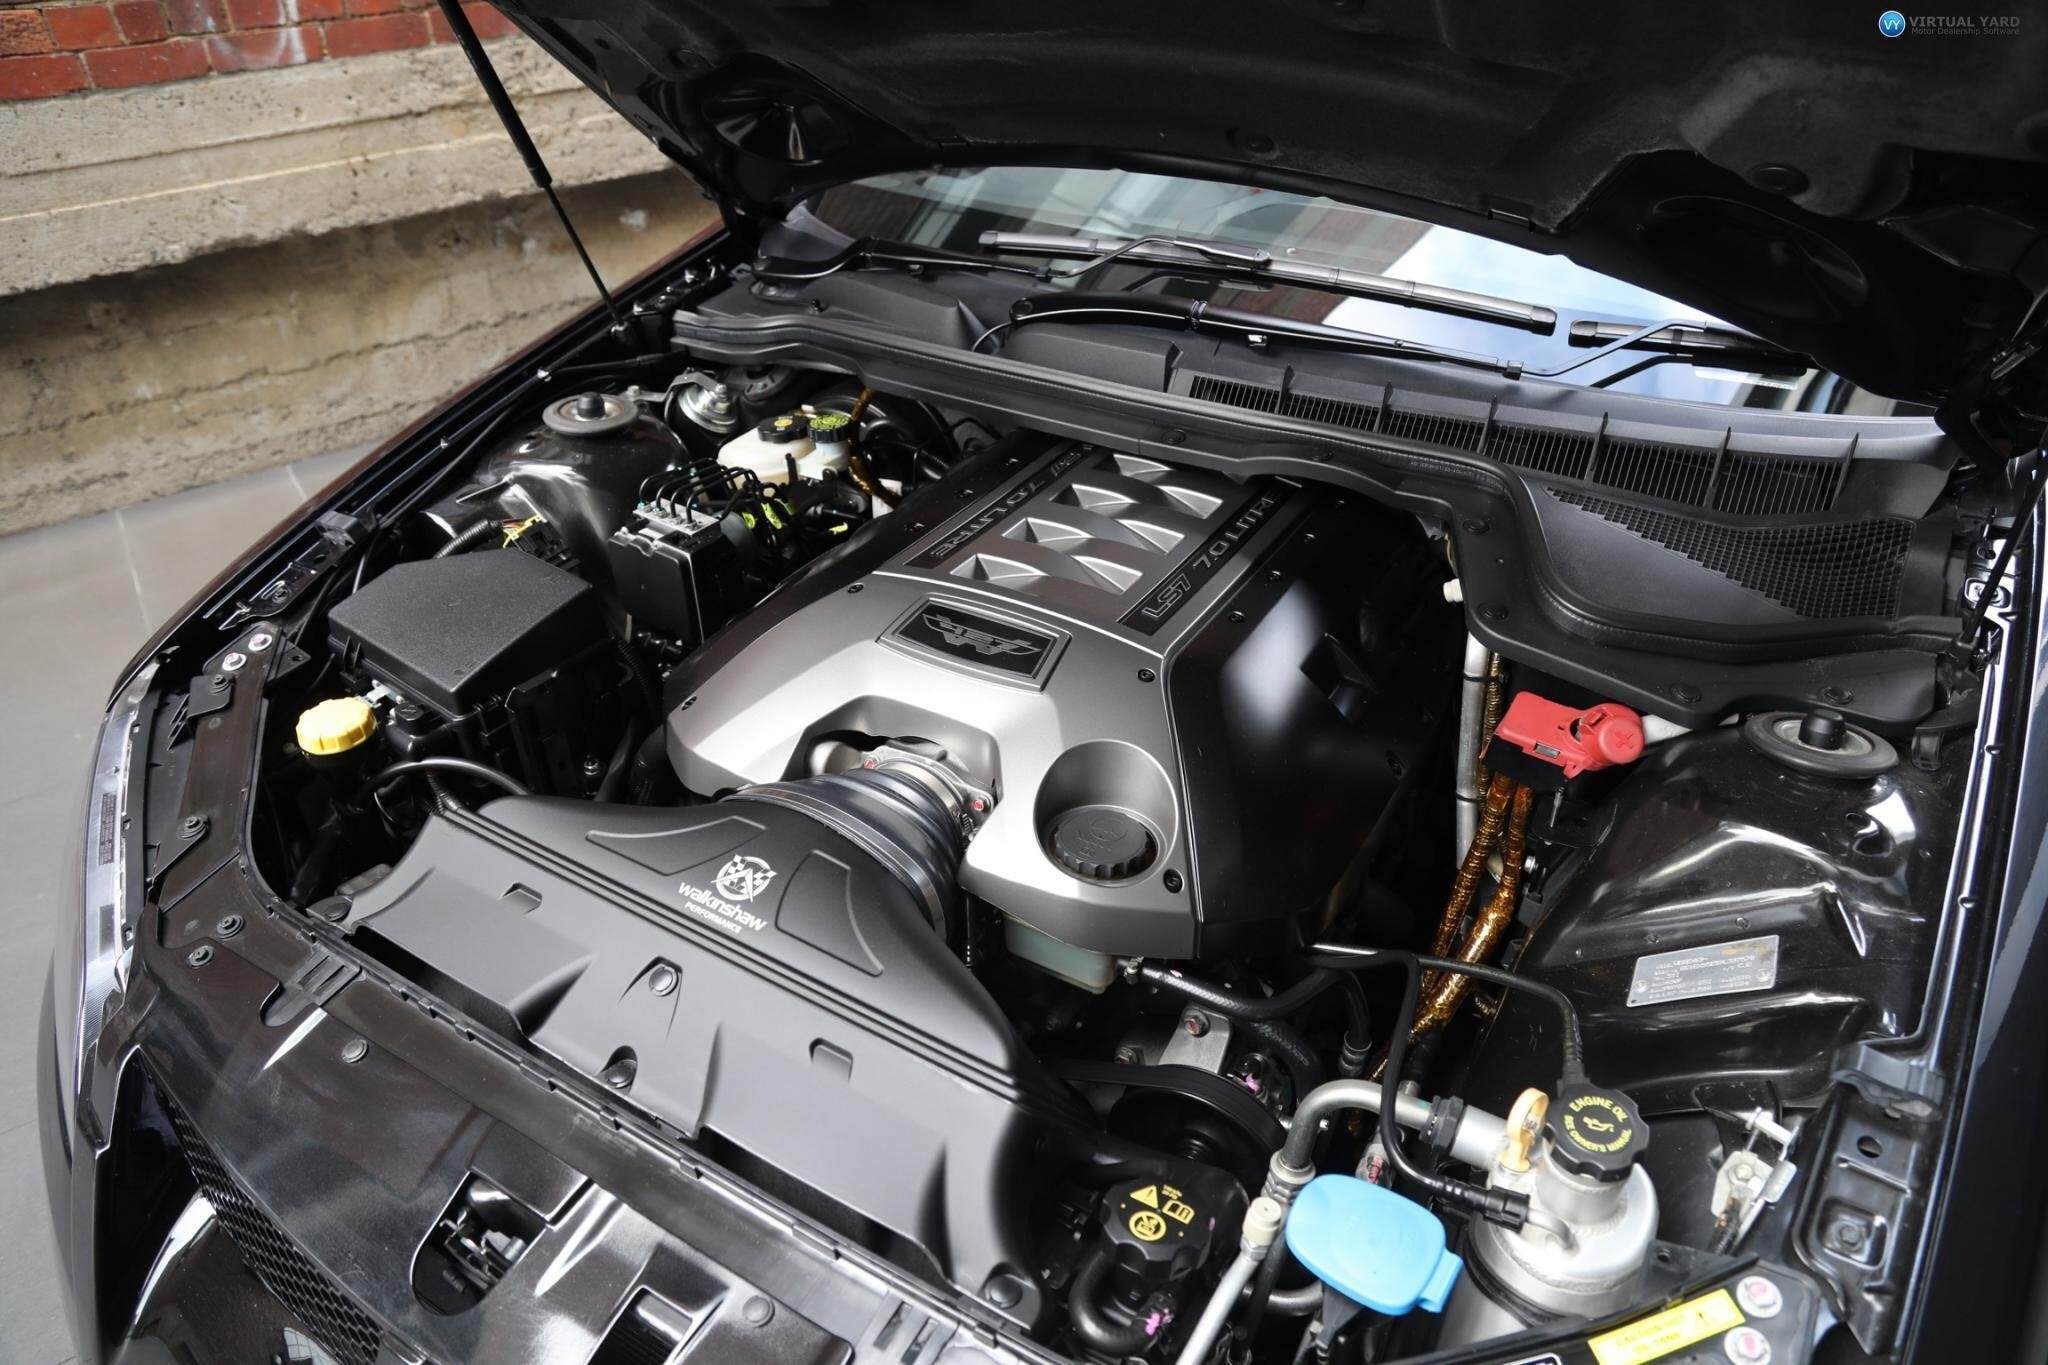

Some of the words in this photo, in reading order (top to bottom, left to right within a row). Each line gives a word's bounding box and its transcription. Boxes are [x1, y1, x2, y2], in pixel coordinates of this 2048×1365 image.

[1142, 573, 1191, 617] LS7
[1192, 540, 1230, 569] 7.0
[678, 882, 767, 931] walkinshaw
[684, 901, 742, 933] PERFORMANCE
[1569, 1096, 1614, 1112] ENGINE
[1611, 1105, 1629, 1123] OIL
